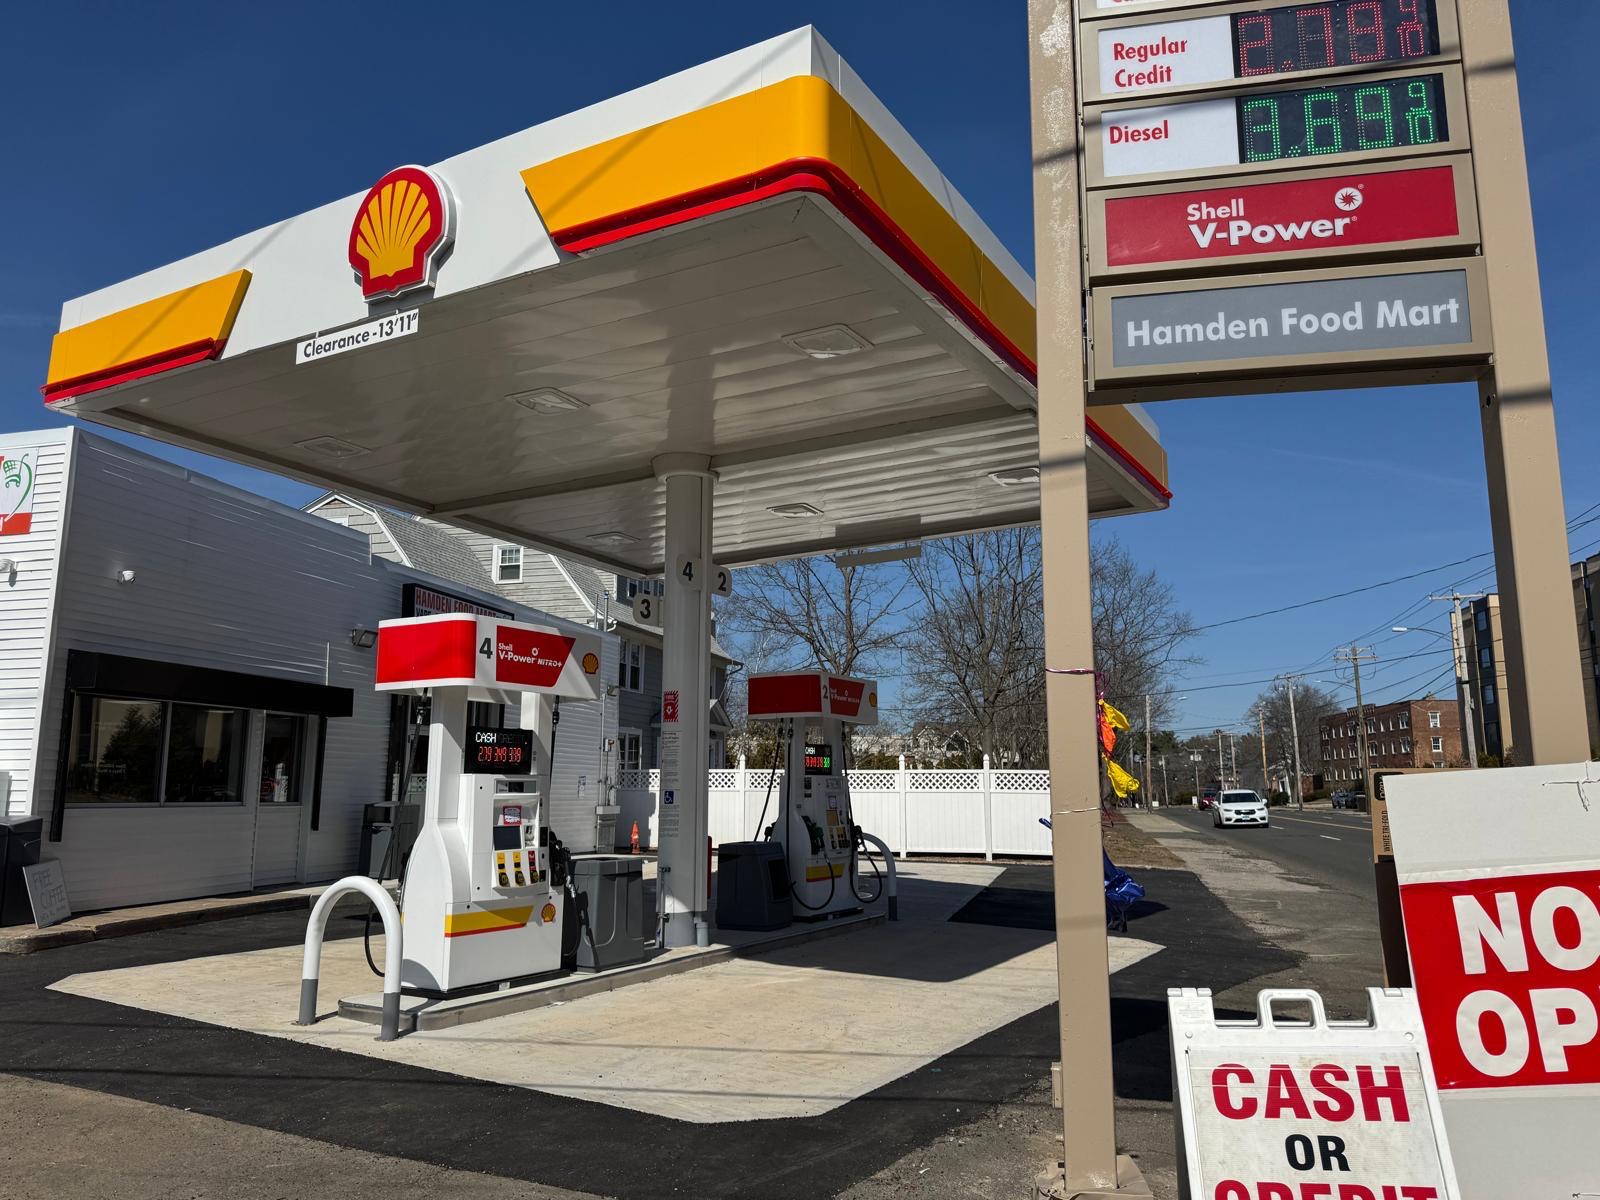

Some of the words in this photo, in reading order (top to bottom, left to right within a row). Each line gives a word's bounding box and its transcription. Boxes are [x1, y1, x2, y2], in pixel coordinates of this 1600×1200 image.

[1113, 36, 1188, 63] Regular
[1238, 1, 1386, 77] 2.79
[1114, 64, 1172, 88] Credit
[1109, 119, 1169, 145] Diesel
[1243, 86, 1394, 162] 3.69
[1186, 198, 1245, 221] Shell
[1188, 217, 1352, 249] V-Power
[1127, 311, 1269, 347] Hamden
[1281, 301, 1364, 335] Food
[1376, 297, 1460, 329] Mart
[303, 331, 370, 358] Clearance
[682, 561, 694, 581] 4
[717, 571, 727, 592] 2
[415, 588, 452, 613] HAMDEN
[640, 598, 651, 619] 3
[479, 637, 494, 660] 4
[498, 642, 513, 651] Shell
[498, 650, 535, 664] V-Power
[537, 658, 563, 668] NITRO+
[822, 684, 829, 700] 2
[475, 731, 497, 743] CASH
[1382, 834, 1391, 853] WHITE
[1452, 885, 1600, 975] NO
[1456, 987, 1600, 1077] OP
[1211, 1063, 1411, 1123] CASH
[1285, 1133, 1351, 1172] OR
